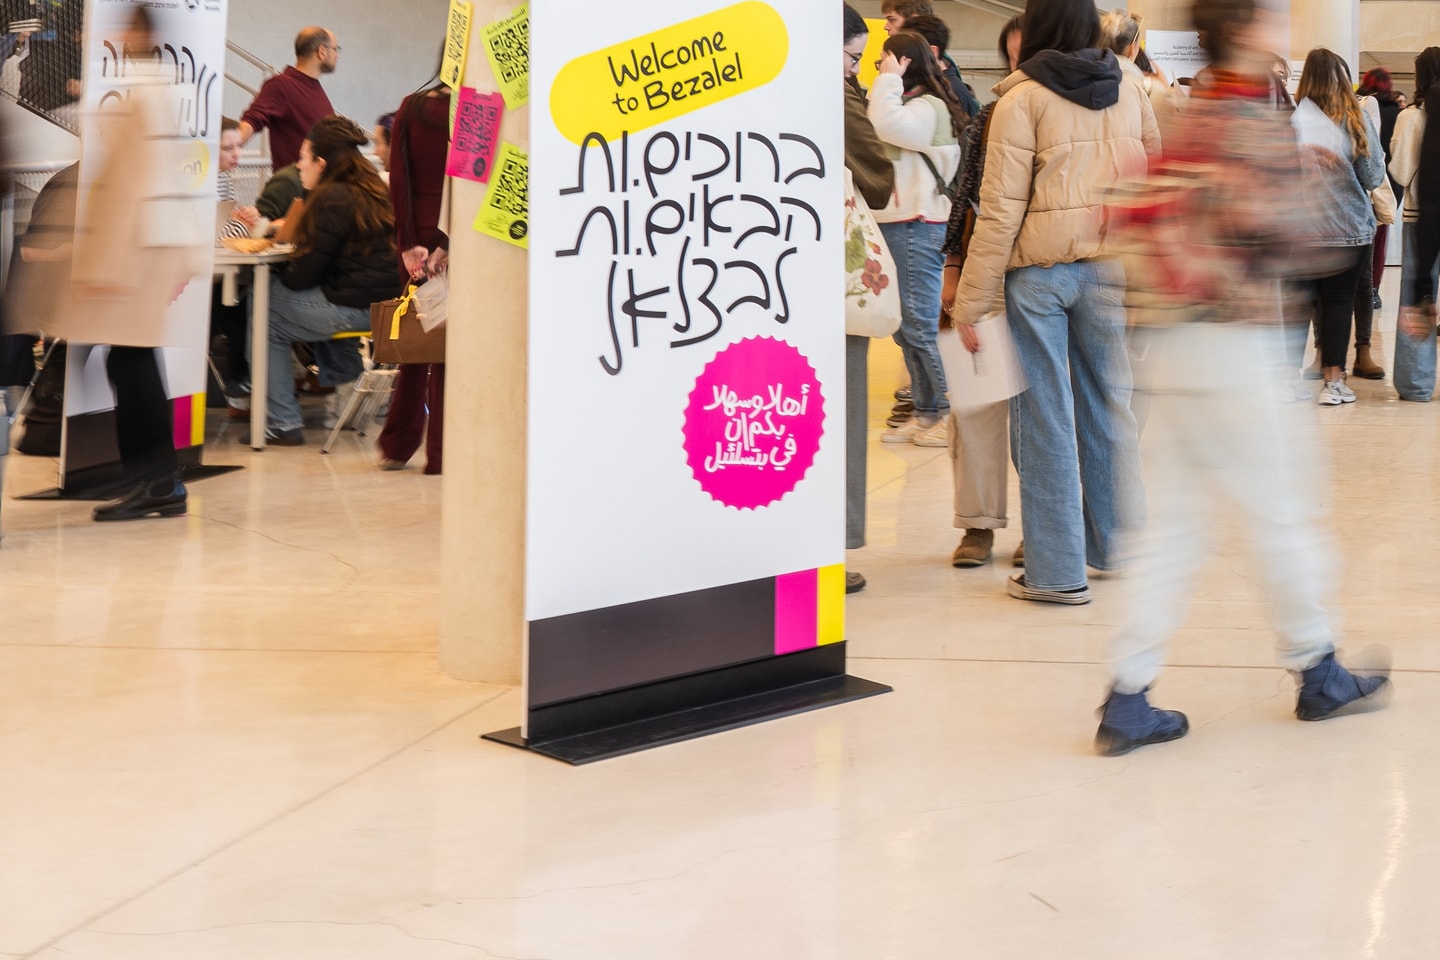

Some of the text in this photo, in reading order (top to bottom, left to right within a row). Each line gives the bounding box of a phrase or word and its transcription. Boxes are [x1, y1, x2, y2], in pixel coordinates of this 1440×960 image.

[607, 30, 728, 87] Welcome
[612, 52, 744, 115] to Bezalel
[599, 235, 798, 376] לבצלאל
[769, 434, 798, 471] في
